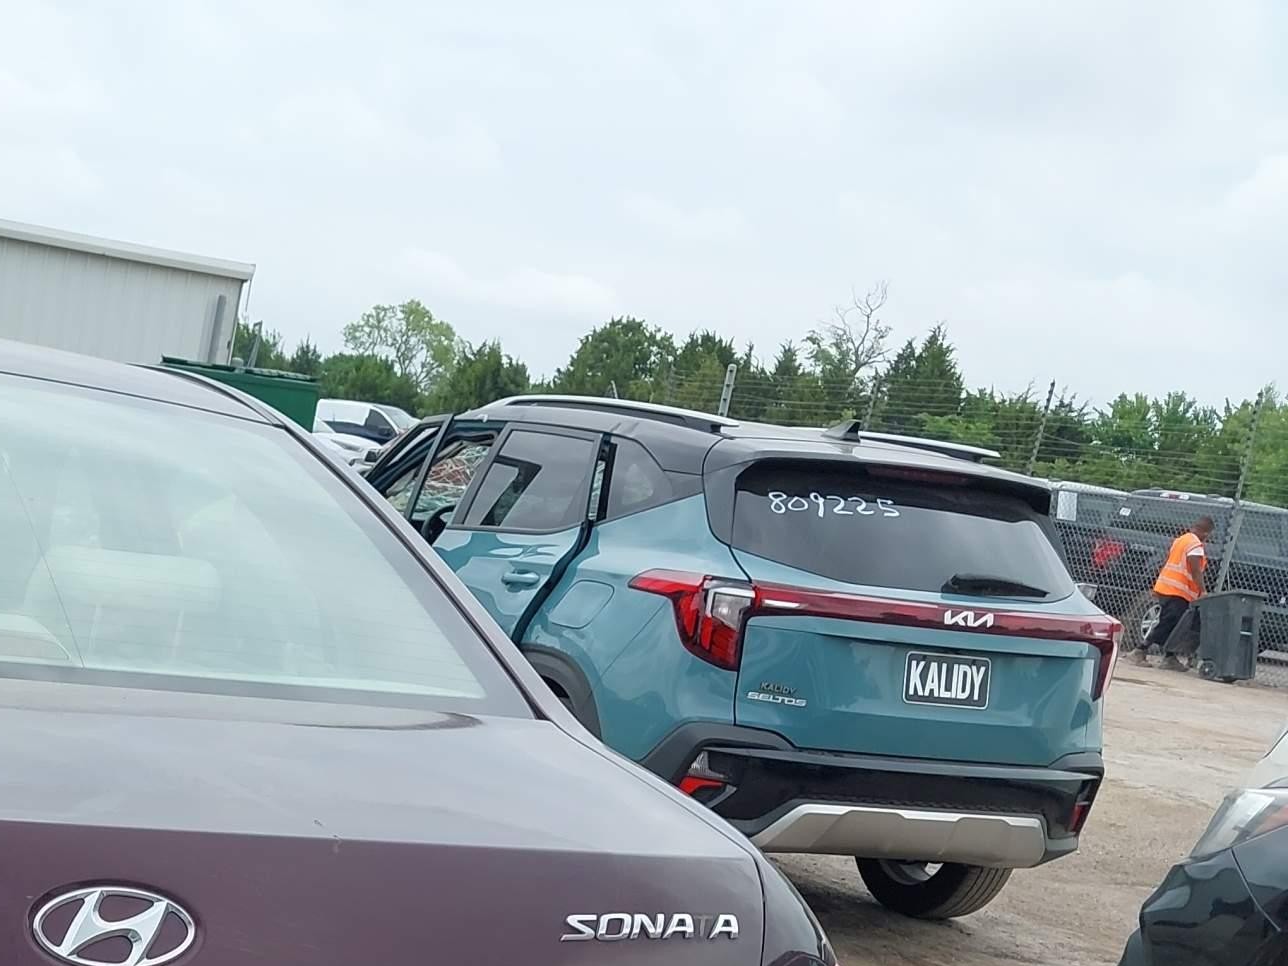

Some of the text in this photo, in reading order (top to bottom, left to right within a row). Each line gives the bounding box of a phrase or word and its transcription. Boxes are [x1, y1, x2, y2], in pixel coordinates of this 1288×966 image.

[768, 491, 900, 518] 809225
[944, 609, 994, 628] KIA
[908, 660, 987, 701] KALIDY
[747, 691, 807, 707] SELTOS
